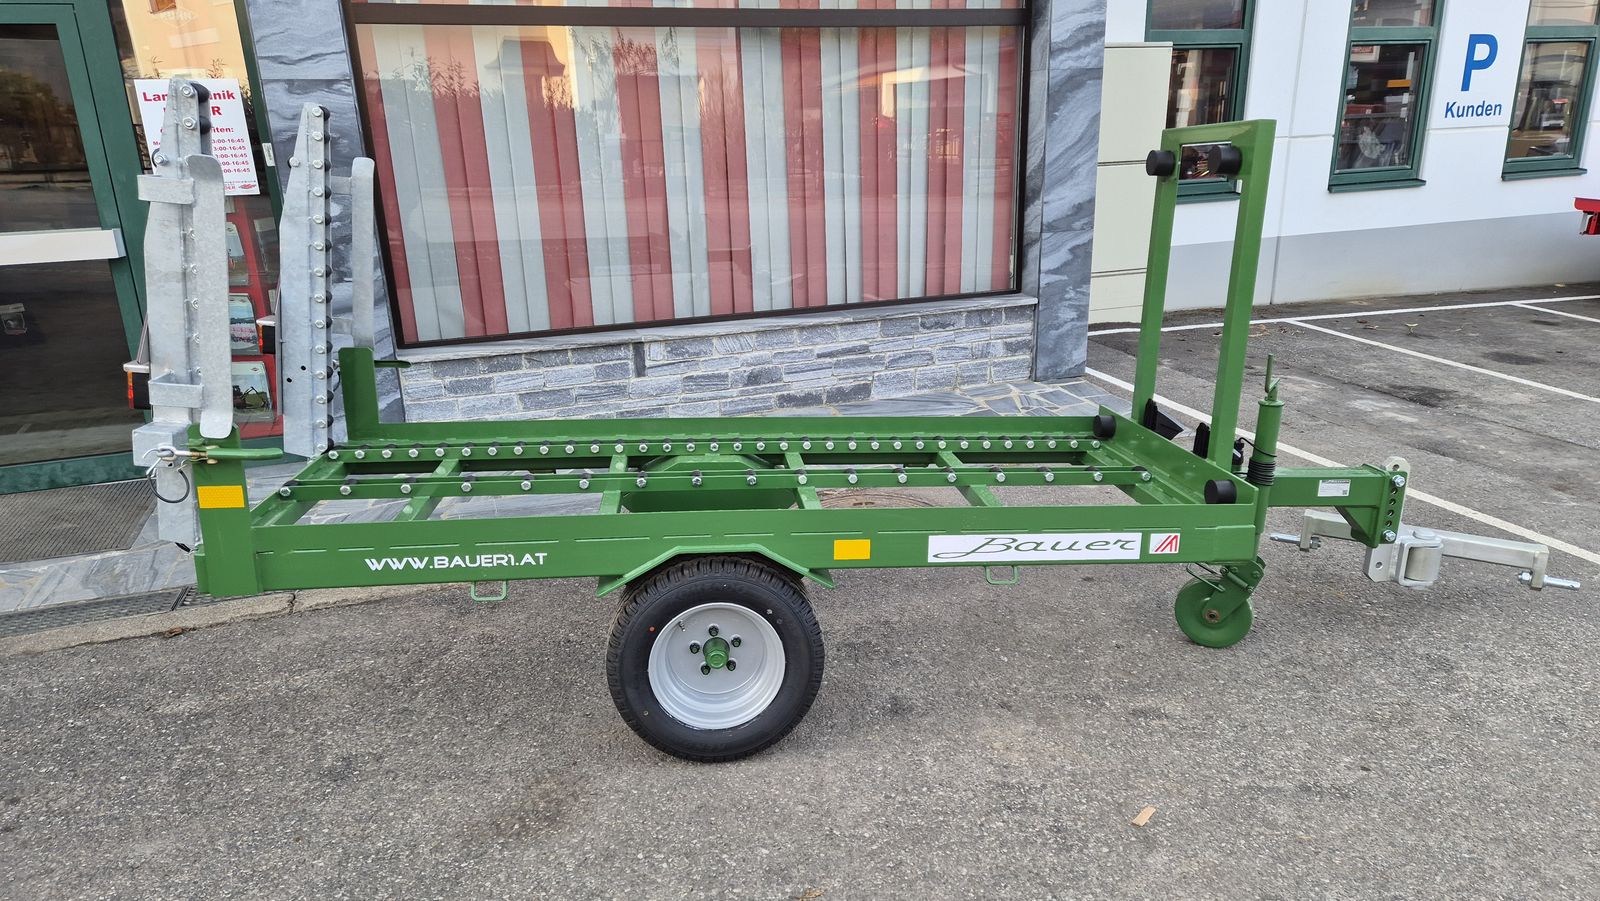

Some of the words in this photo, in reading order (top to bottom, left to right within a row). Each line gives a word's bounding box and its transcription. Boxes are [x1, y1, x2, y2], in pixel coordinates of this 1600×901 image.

[1460, 34, 1498, 91] P
[1444, 100, 1502, 118] Kunden
[932, 537, 1136, 559] Bauer
[365, 553, 548, 571] WWW.BAUER1.AT
